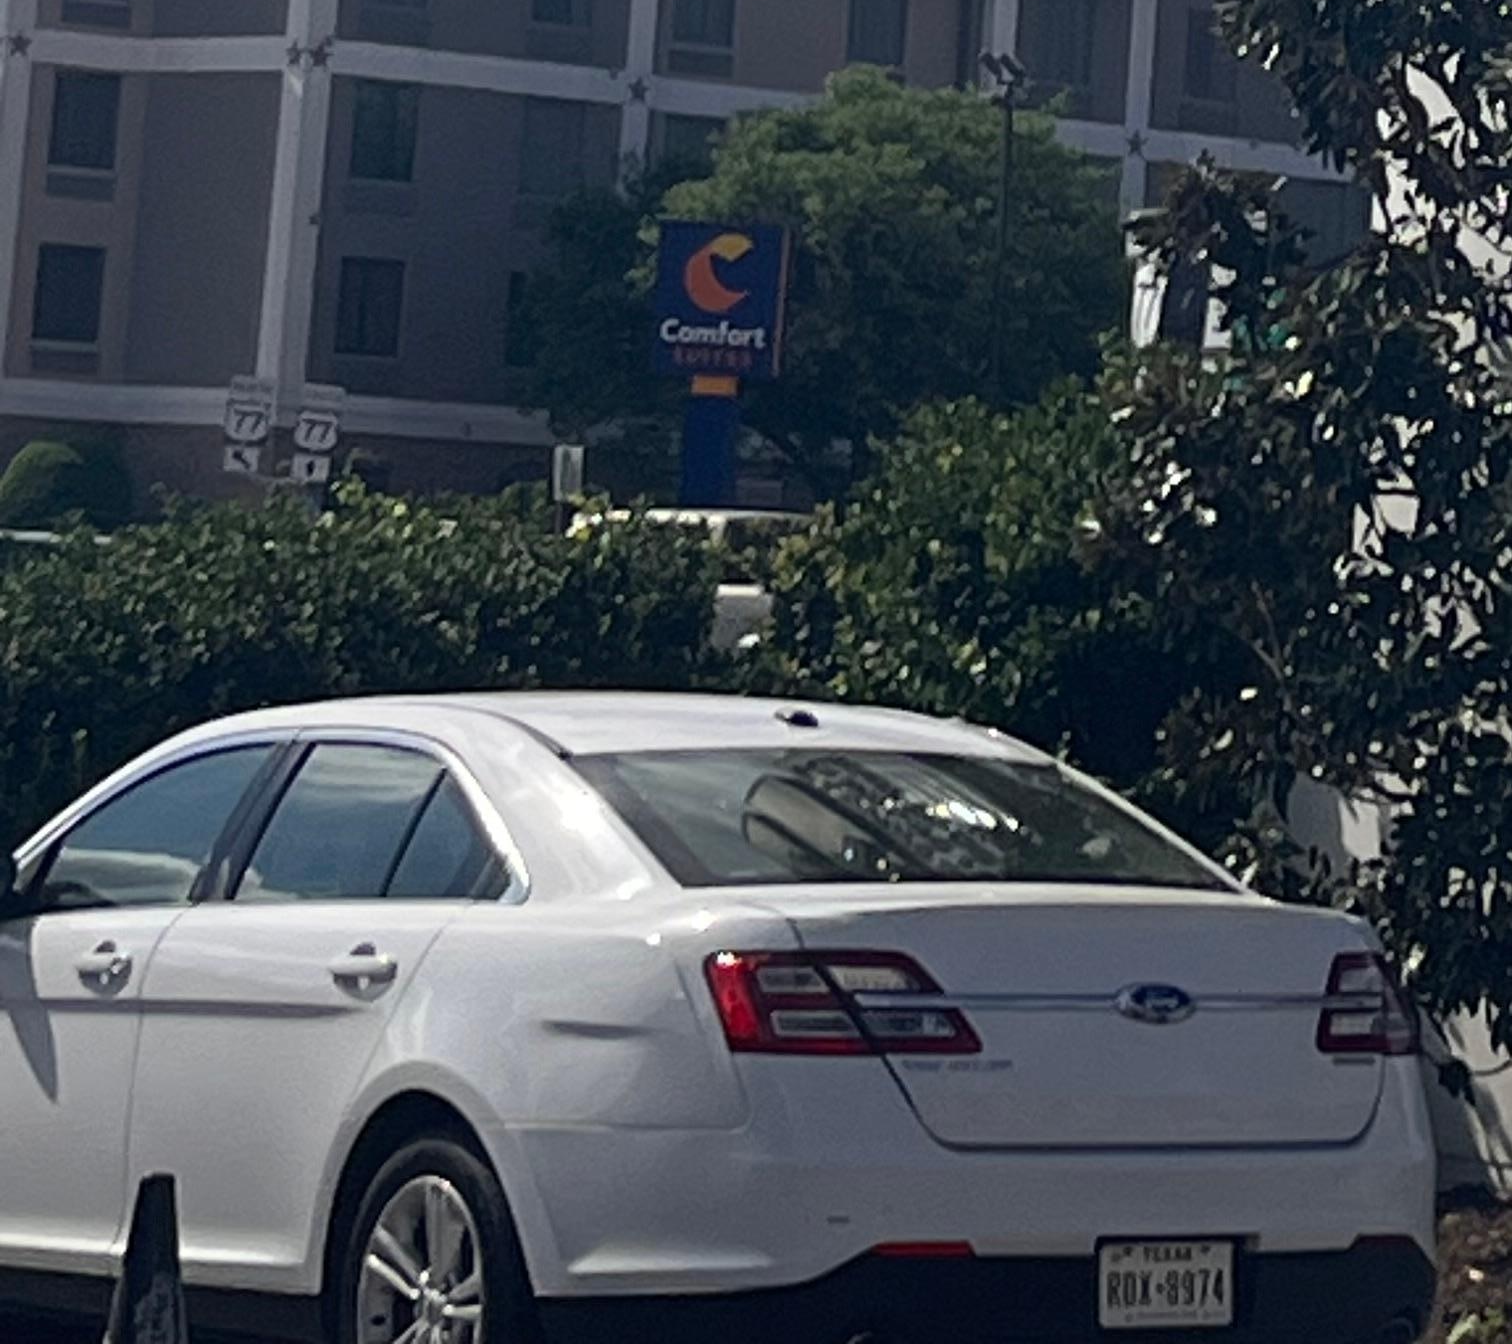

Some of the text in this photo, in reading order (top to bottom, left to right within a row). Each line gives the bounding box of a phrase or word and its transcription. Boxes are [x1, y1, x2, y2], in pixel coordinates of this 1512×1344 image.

[659, 317, 766, 349] Comfort
[233, 409, 266, 434] 77
[301, 418, 334, 443] 77
